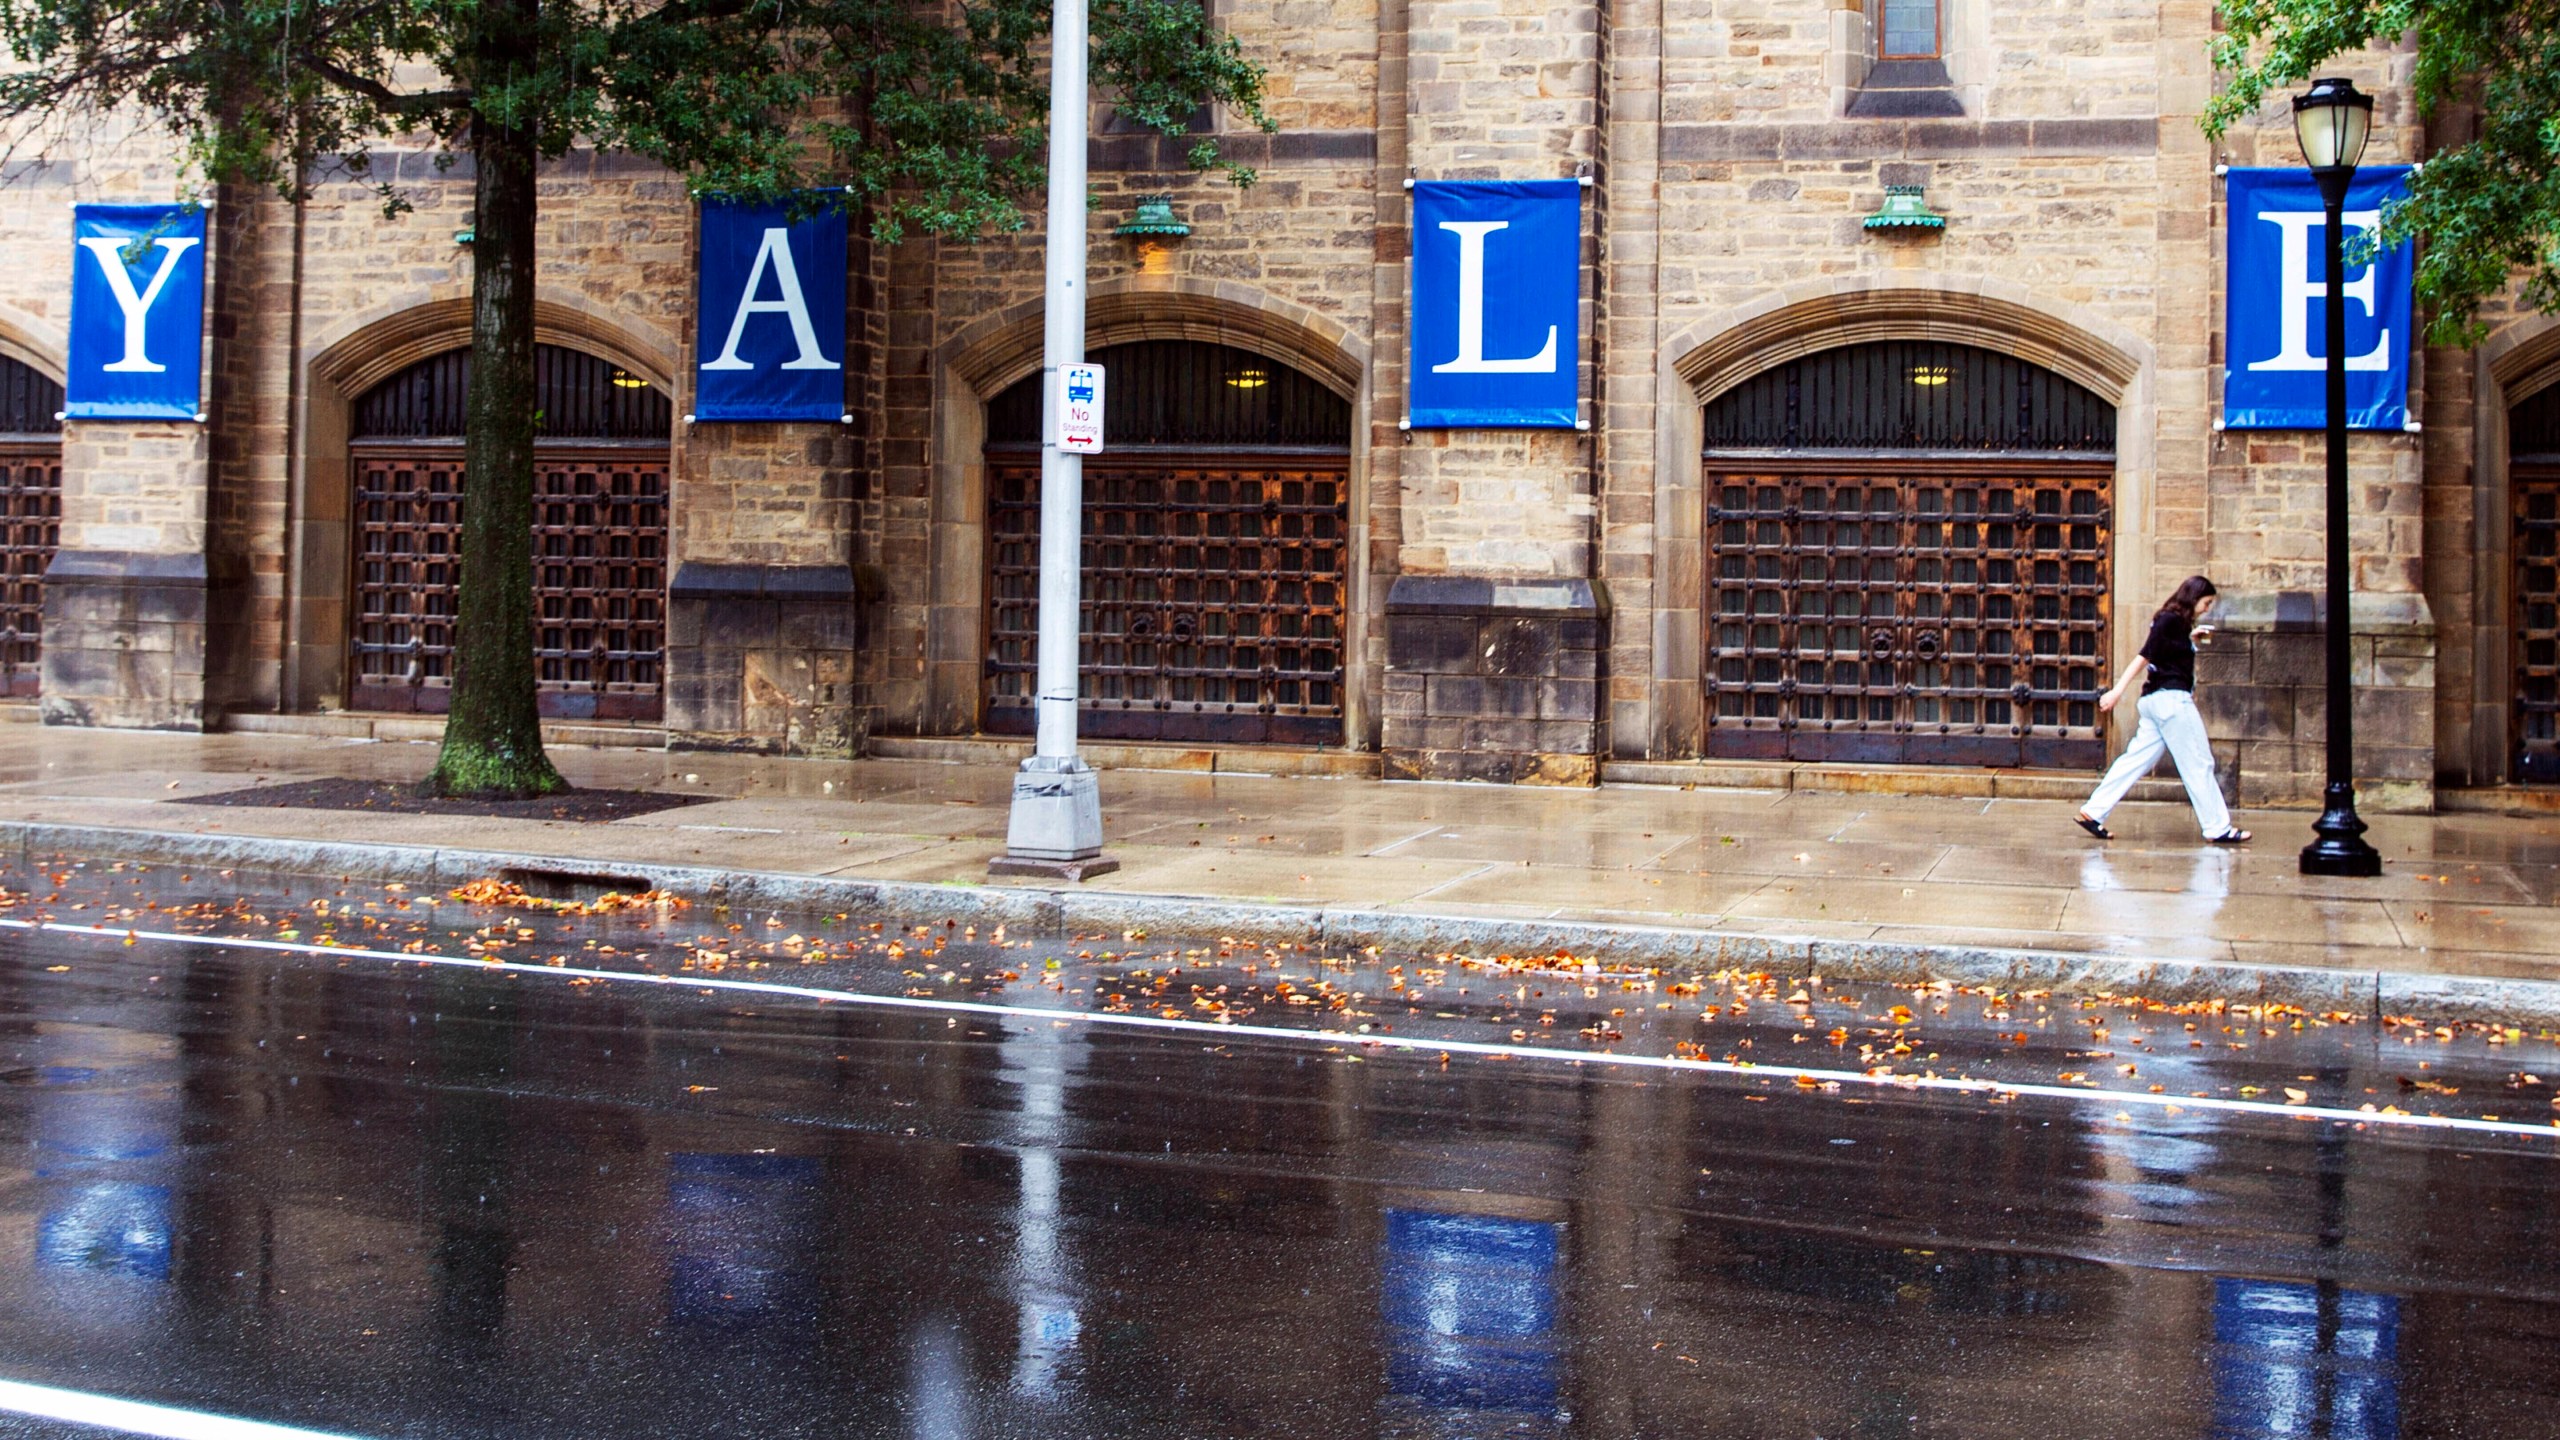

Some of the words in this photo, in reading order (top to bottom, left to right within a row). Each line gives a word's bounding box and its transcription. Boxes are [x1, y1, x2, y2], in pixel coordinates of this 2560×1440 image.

[79, 236, 200, 372] Y
[700, 228, 841, 370] A
[1432, 221, 1557, 373] L
[2248, 210, 2390, 371] E
[1062, 422, 1098, 435] Standing
[1072, 407, 1089, 421] No
